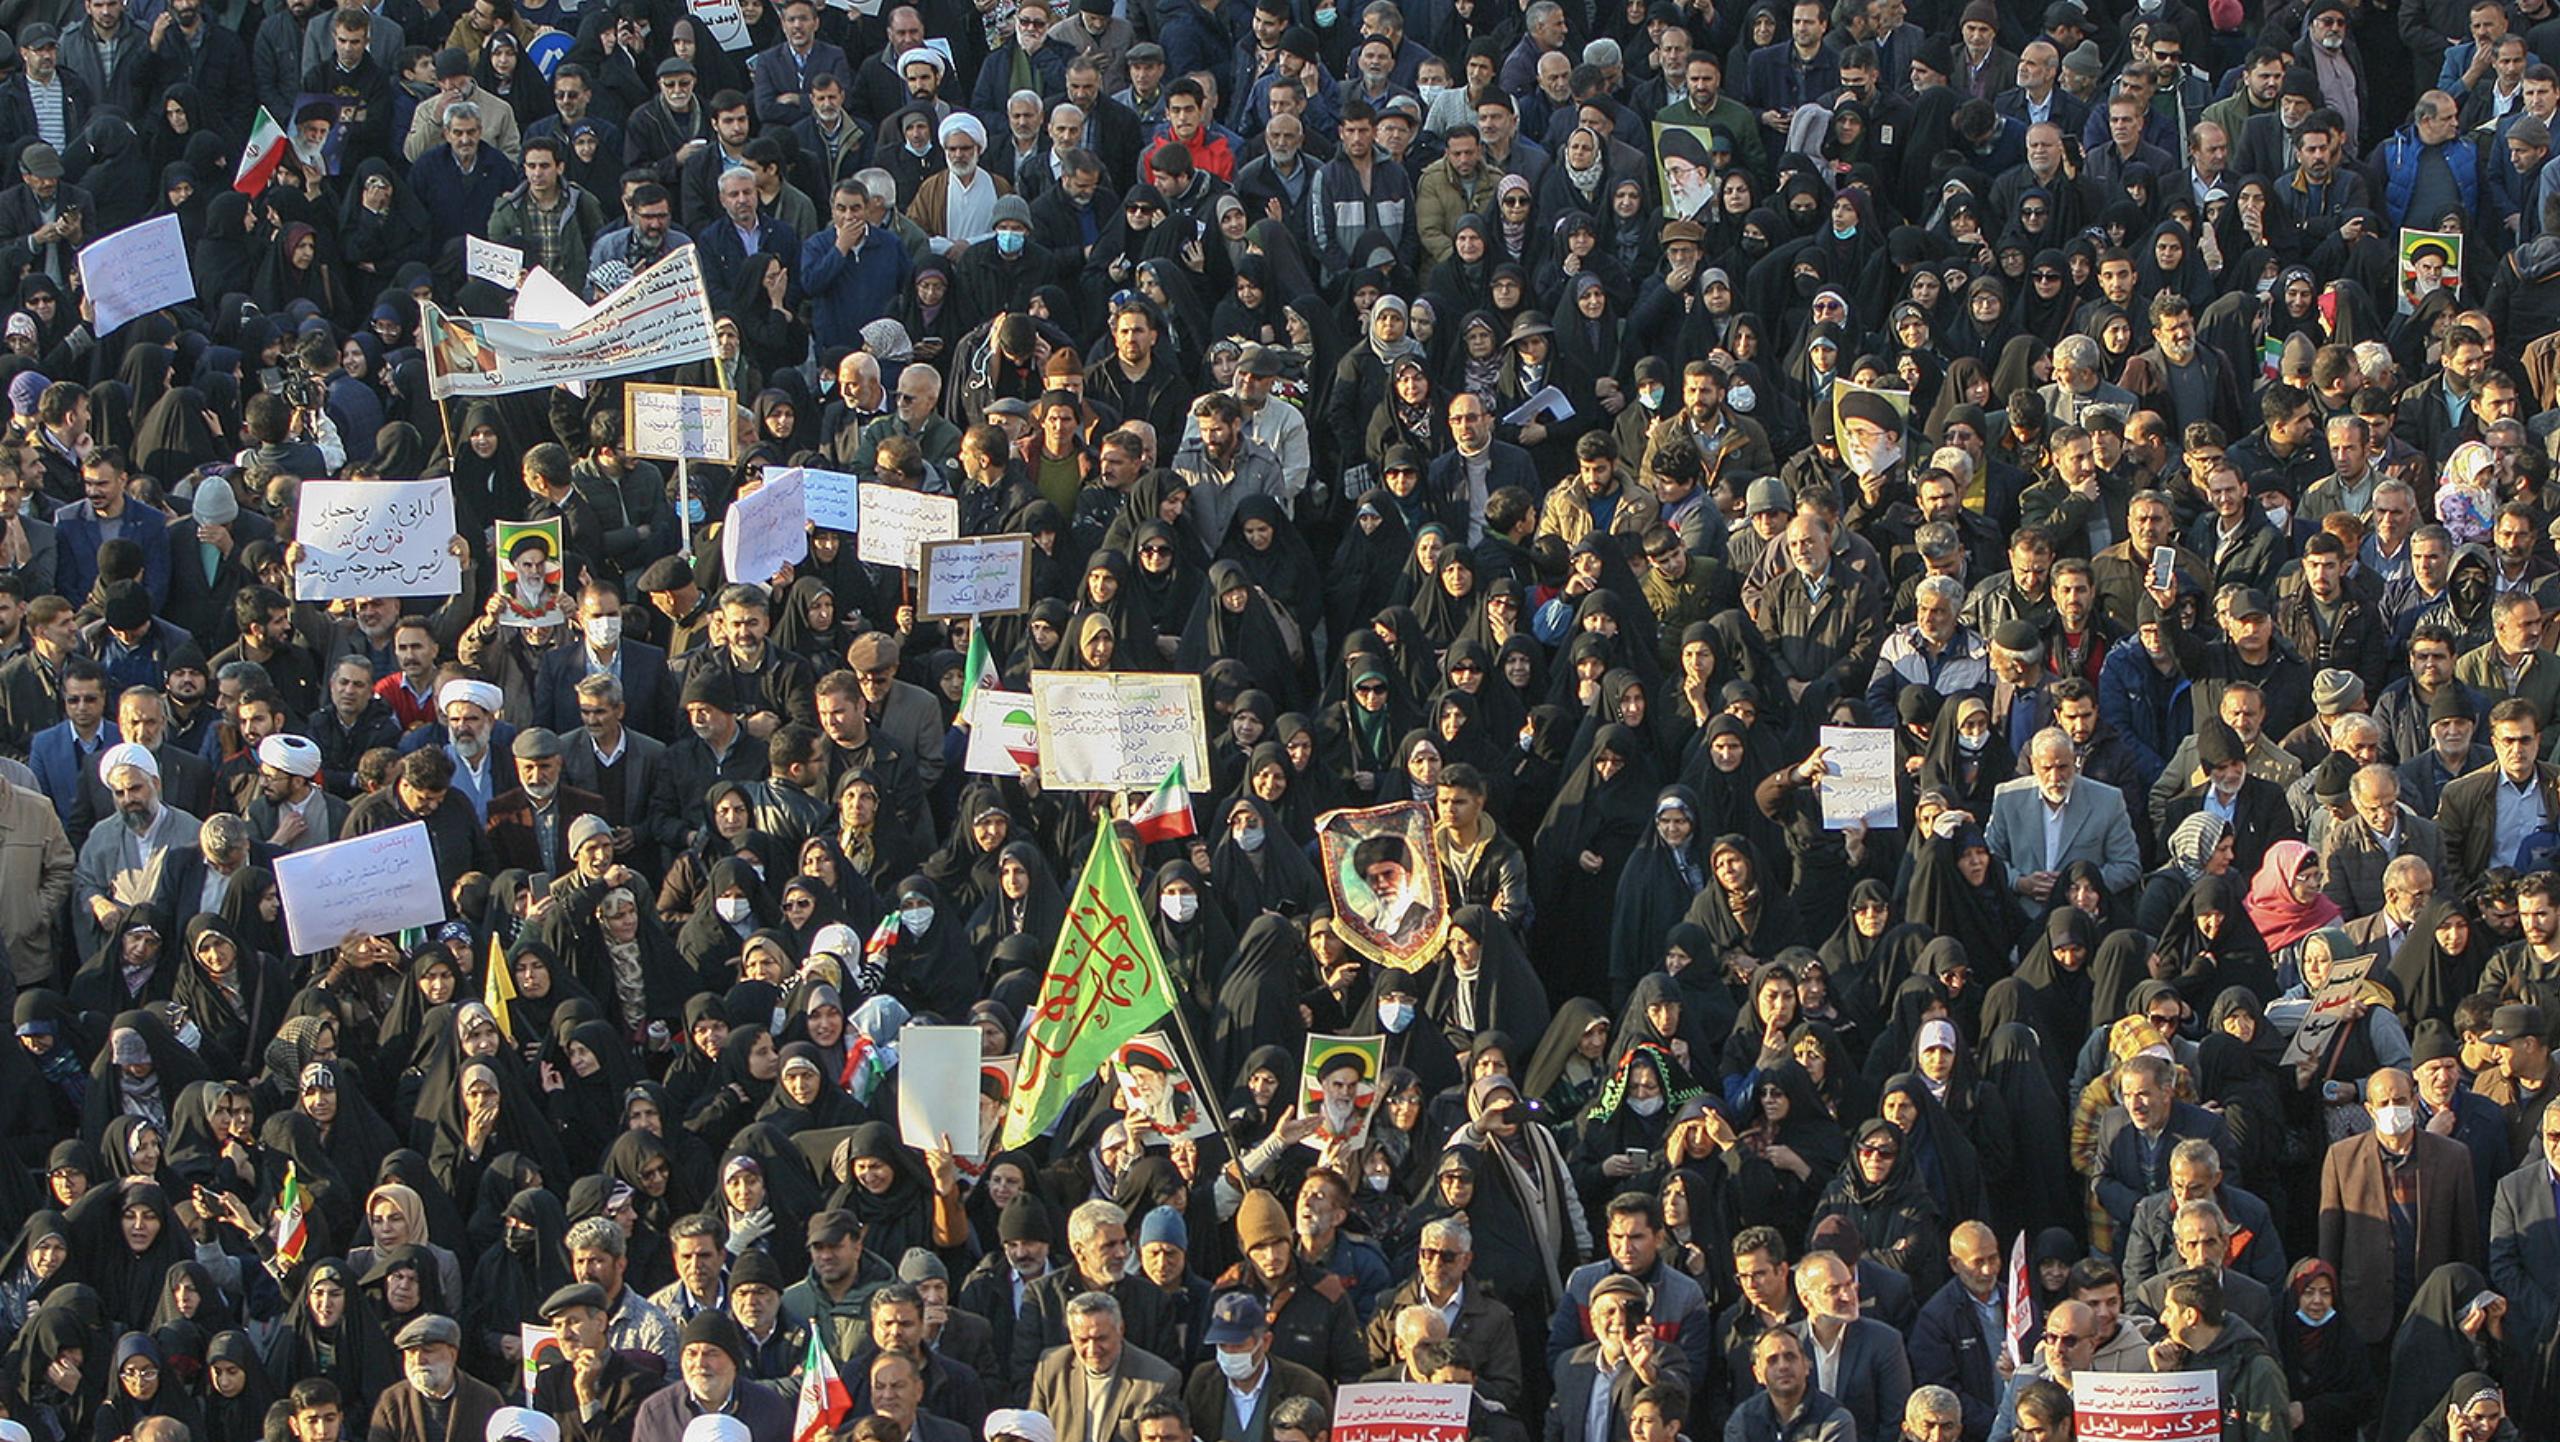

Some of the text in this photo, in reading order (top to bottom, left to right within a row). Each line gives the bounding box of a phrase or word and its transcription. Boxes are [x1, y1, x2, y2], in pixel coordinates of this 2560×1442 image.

[312, 500, 355, 530] حجابی
[354, 505, 371, 525] بی
[337, 525, 404, 555] فرق می کند
[303, 558, 328, 582] باشد
[326, 551, 358, 583] کسی
[364, 559, 403, 580] جمهور
[1155, 703, 1171, 718] ملی
[1169, 701, 1187, 717] پول
[2116, 1385, 2130, 1397] این
[2130, 1386, 2140, 1396] در
[2140, 1386, 2151, 1396] هم
[2079, 1413, 2218, 1438] مرگ بر اسرائیل
